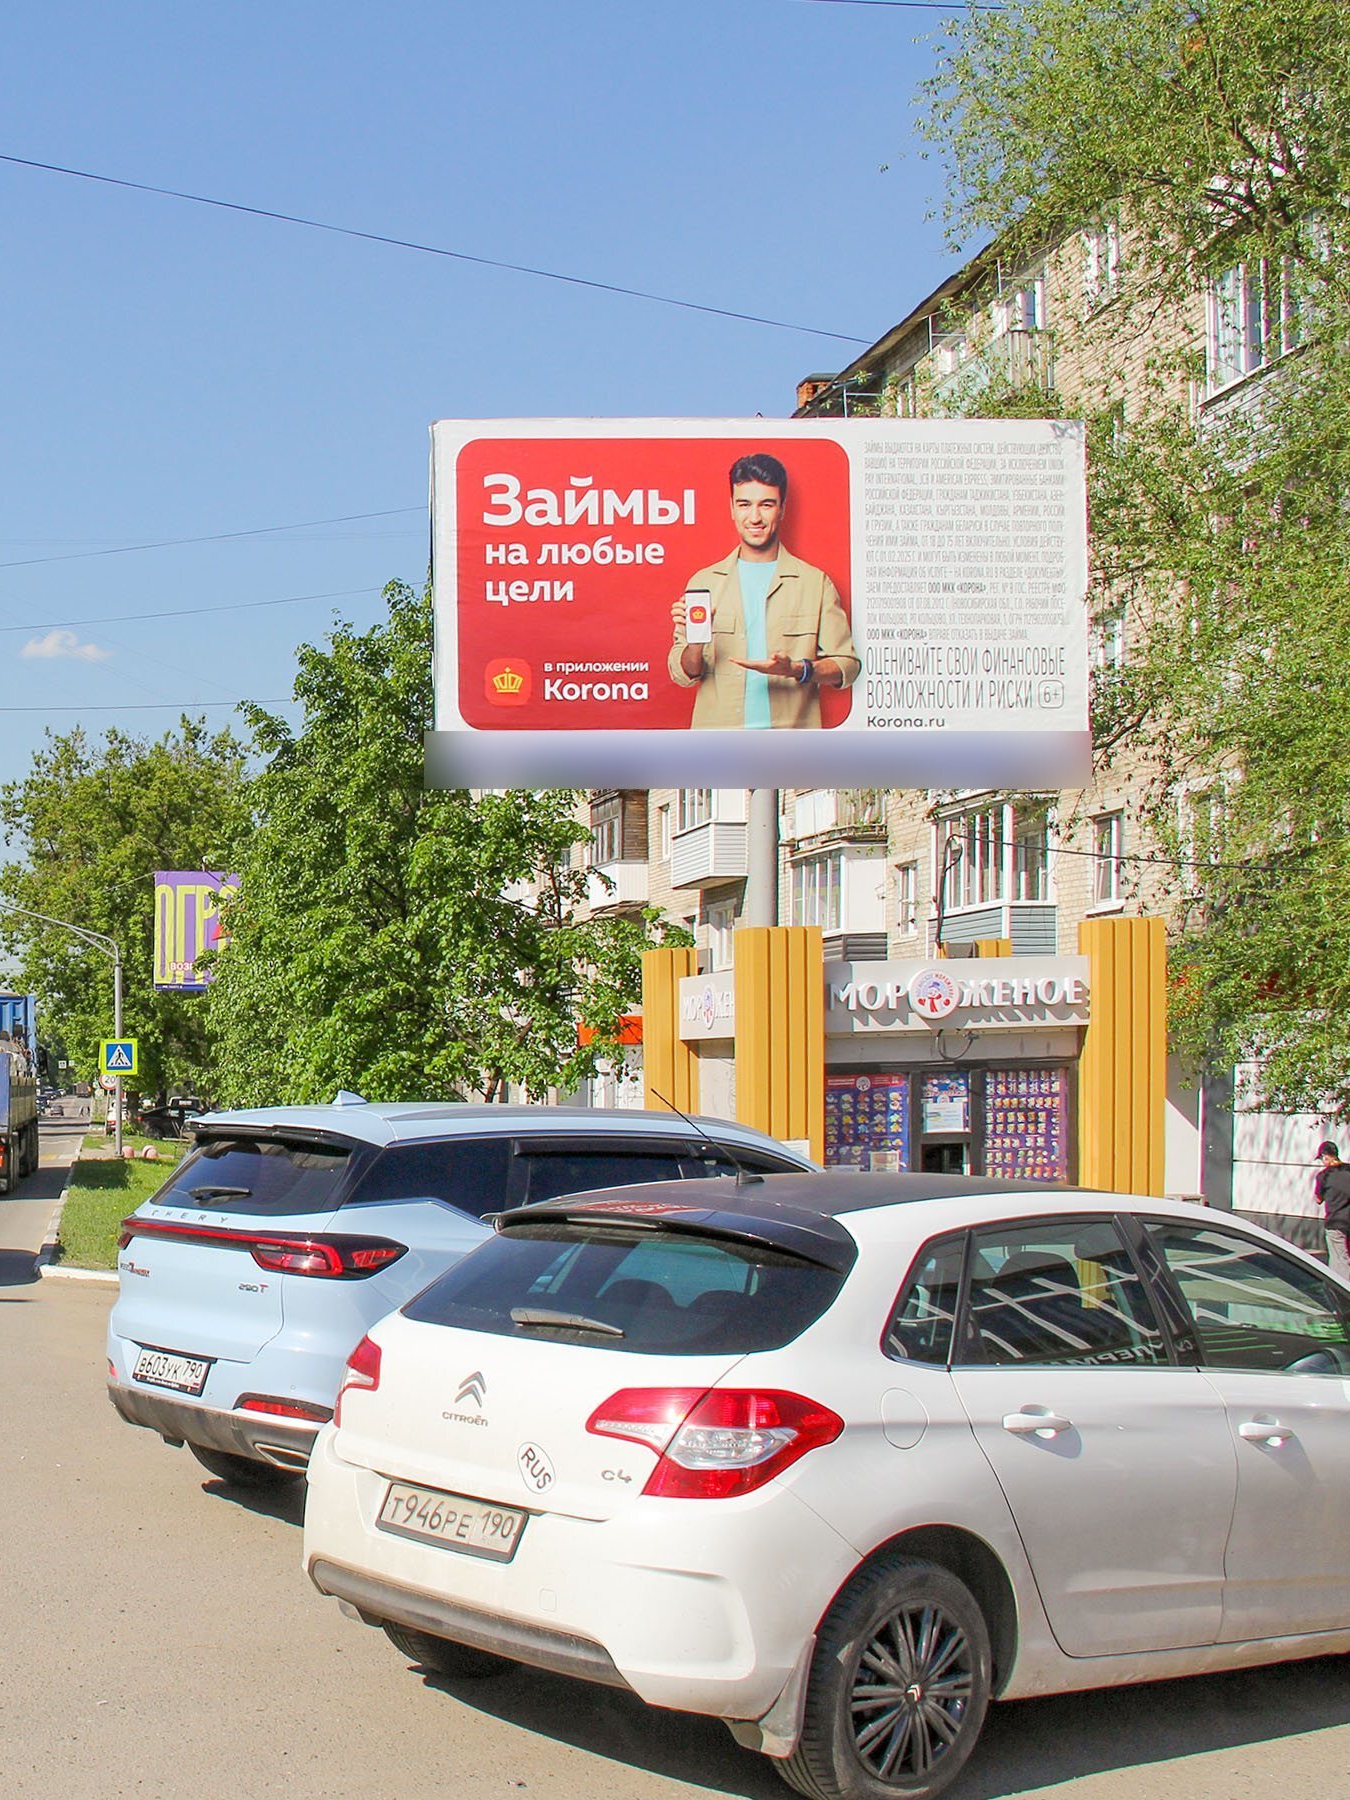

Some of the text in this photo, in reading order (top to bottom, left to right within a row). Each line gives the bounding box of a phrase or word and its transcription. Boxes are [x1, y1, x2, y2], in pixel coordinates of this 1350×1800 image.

[483, 473, 695, 526] Займы
[485, 535, 665, 565] на любые
[485, 580, 574, 606] цели
[544, 662, 649, 676] в приложении
[866, 643, 1065, 677] ОЦЕНИВАЙТЕ СВОИ ФИНАНСОВЫЕ
[544, 679, 649, 701] Korona
[867, 680, 1033, 709] ВОЗМОЖНОСТИ И РИСКИ
[1043, 686, 1060, 704] 6+
[866, 716, 945, 728] Korona.ru
[155, 884, 238, 983] ОГР
[104, 1075, 116, 1083] 20
[151, 1209, 228, 1224] CHERY
[138, 1355, 203, 1379] В603УК 790
[520, 1447, 553, 1490] RUS
[601, 1468, 632, 1484] C4
[389, 1494, 516, 1540] Т946РЕ 190
